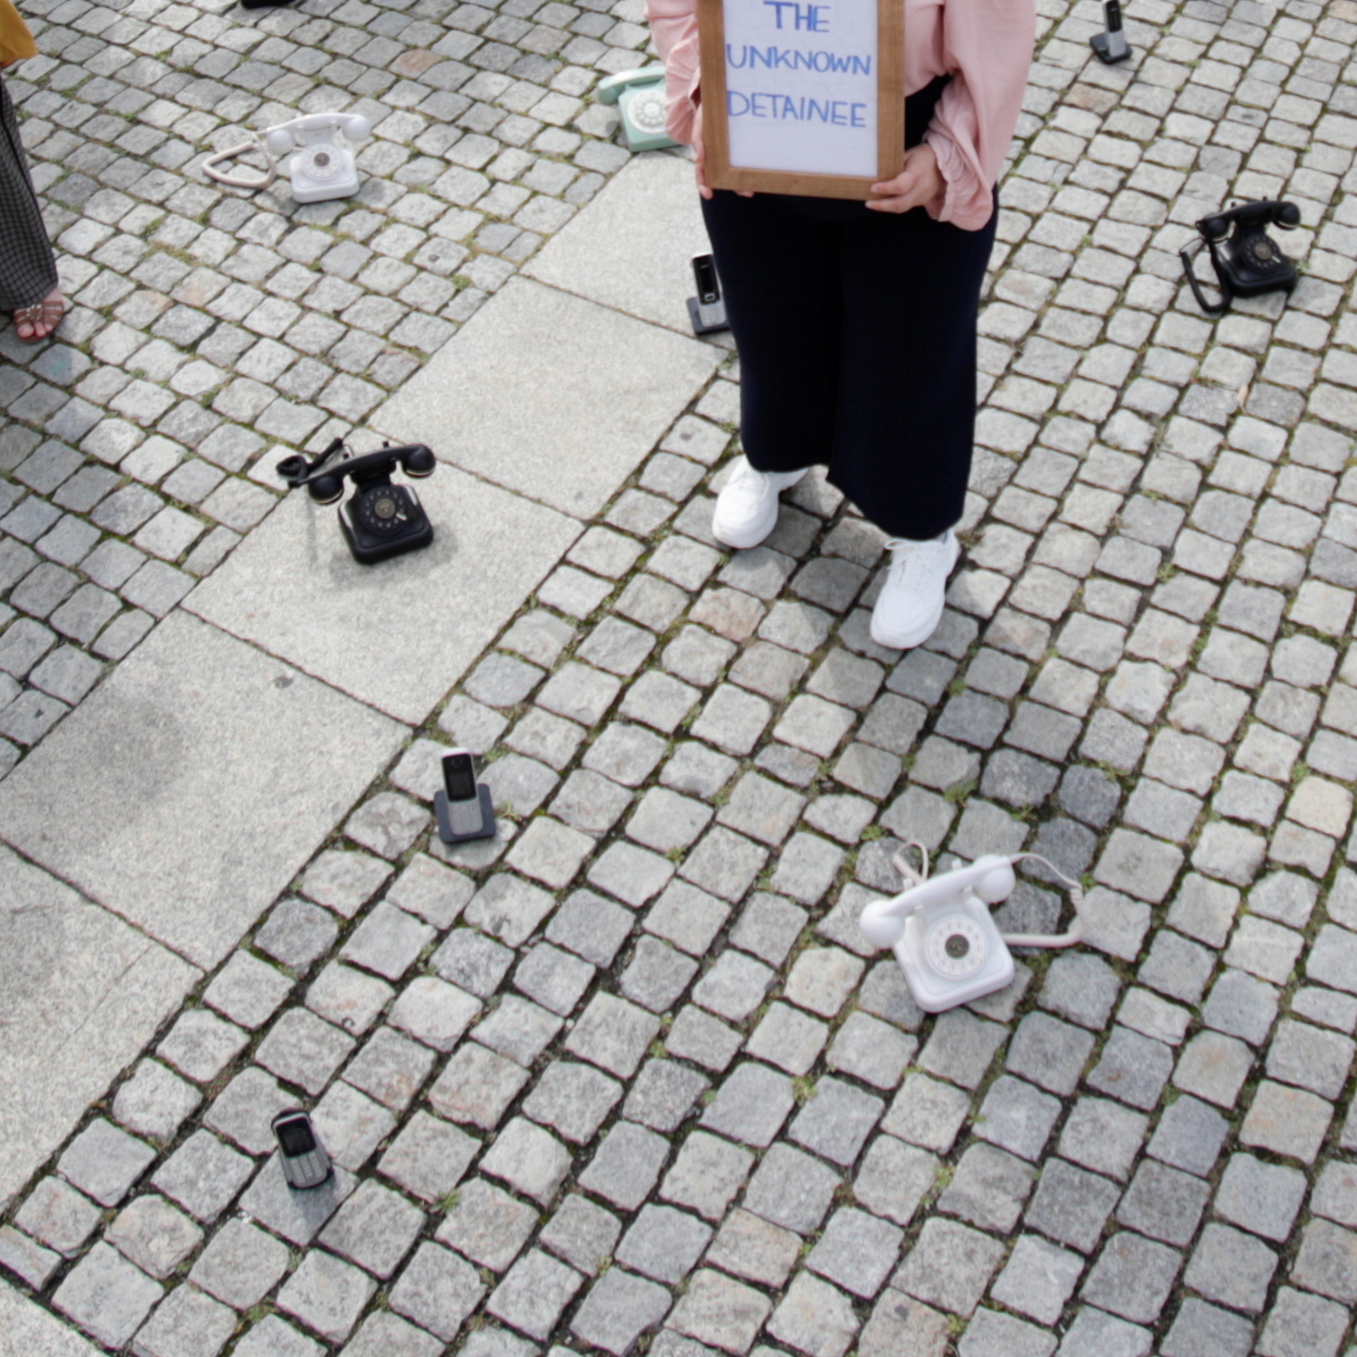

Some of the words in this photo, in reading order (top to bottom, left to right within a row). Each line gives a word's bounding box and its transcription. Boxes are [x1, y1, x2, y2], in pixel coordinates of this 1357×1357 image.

[763, 0, 831, 33] THE
[725, 43, 872, 76] UNKNOWN
[726, 90, 867, 128] DETAINEE
